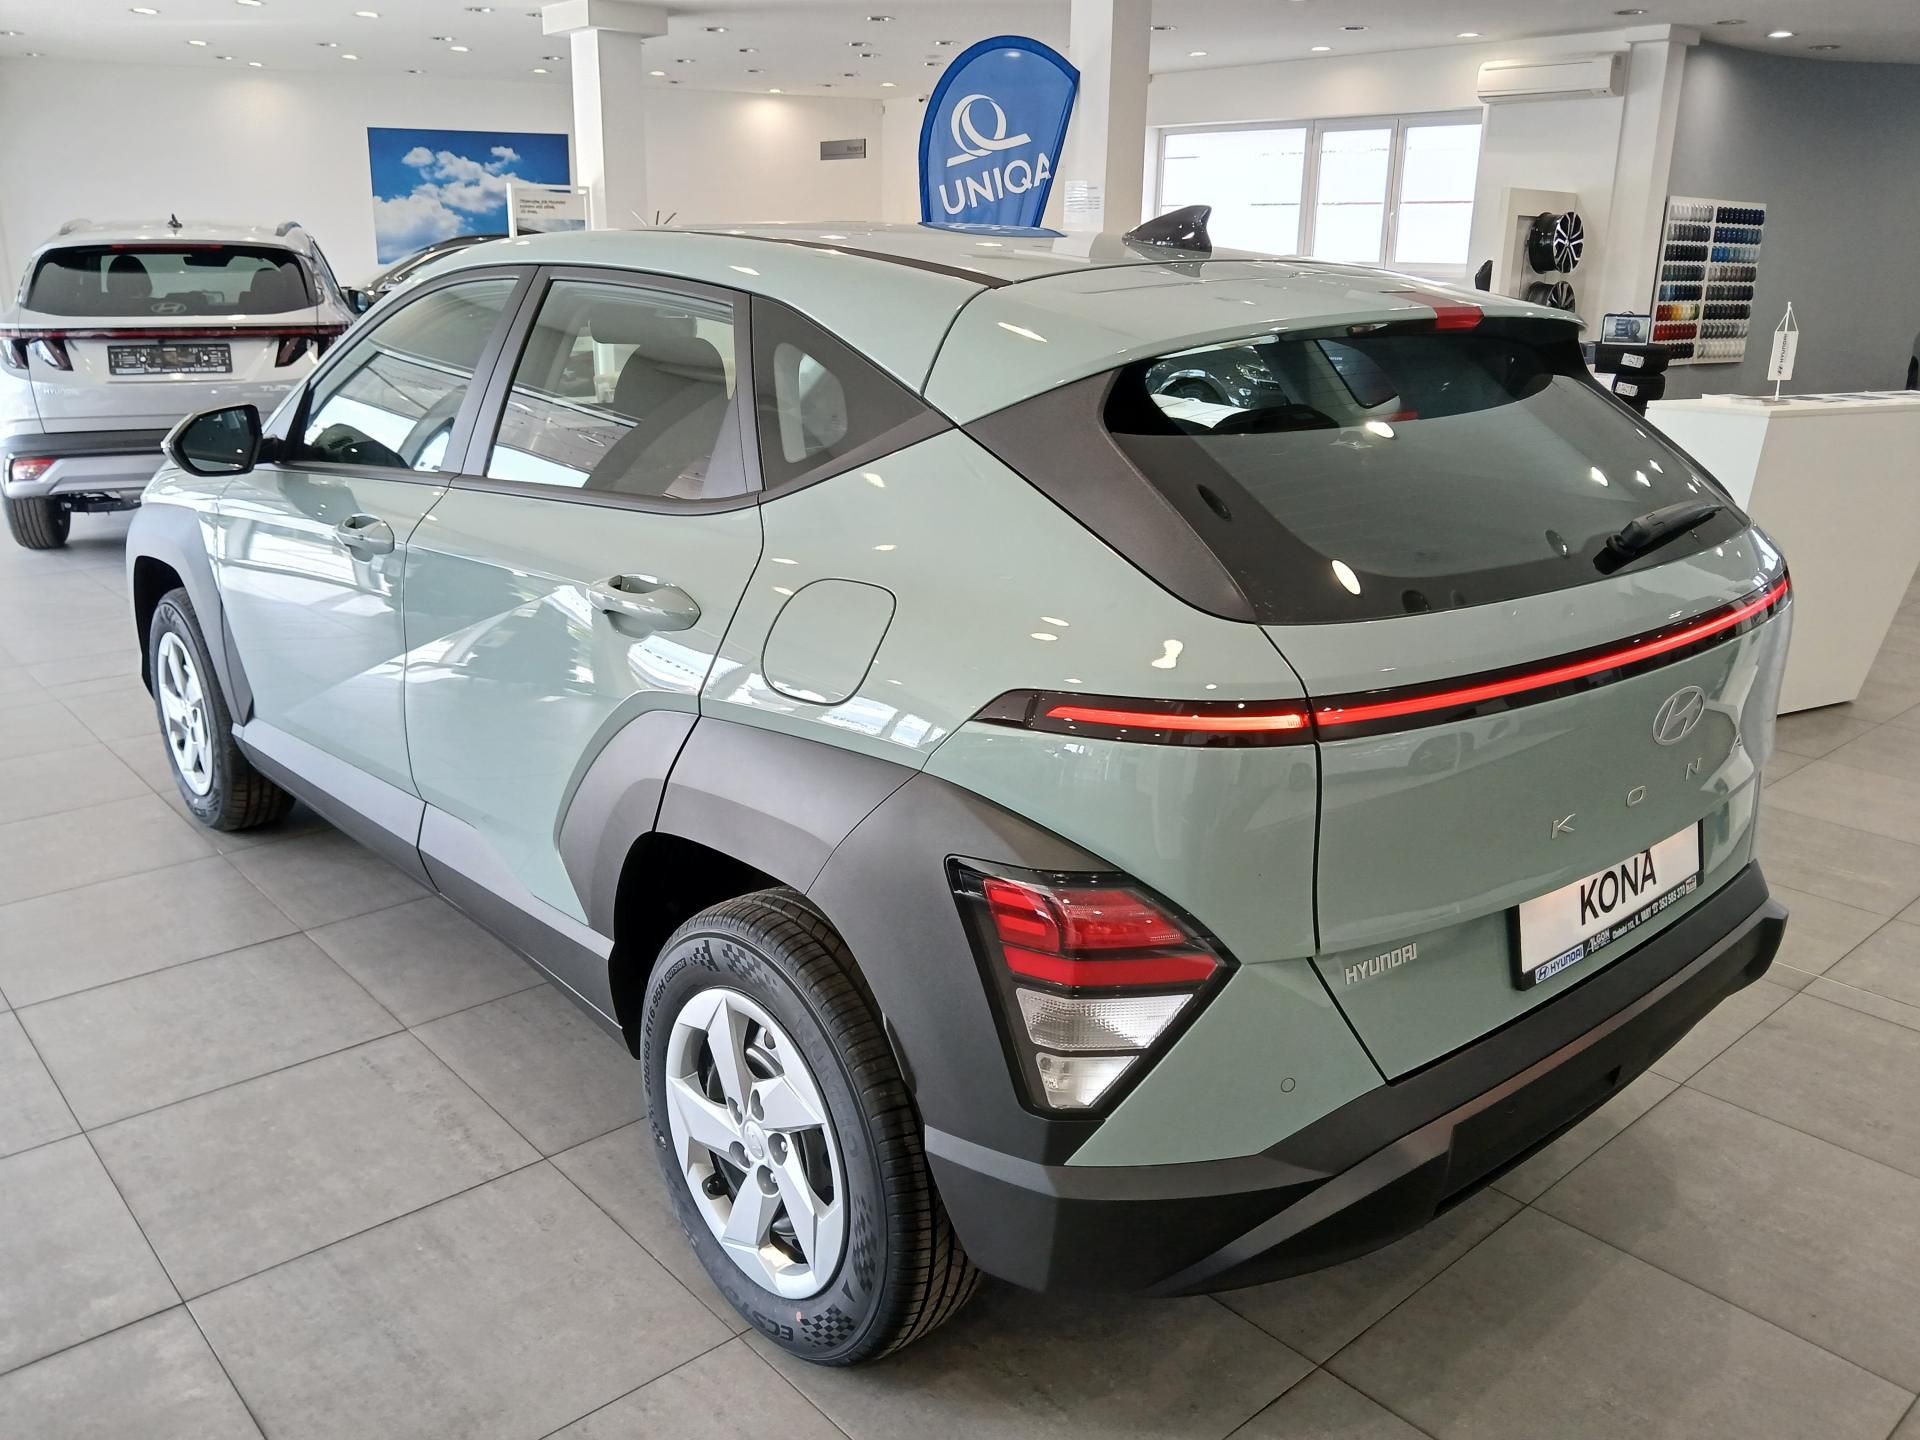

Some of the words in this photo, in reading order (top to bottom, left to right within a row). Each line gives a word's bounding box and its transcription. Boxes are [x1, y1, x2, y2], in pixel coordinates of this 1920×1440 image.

[939, 152, 1051, 215] UNIQA
[1580, 847, 1657, 926] KONA
[1345, 943, 1417, 985] HYUNDAI
[1550, 946, 1583, 973] HYUNDAI
